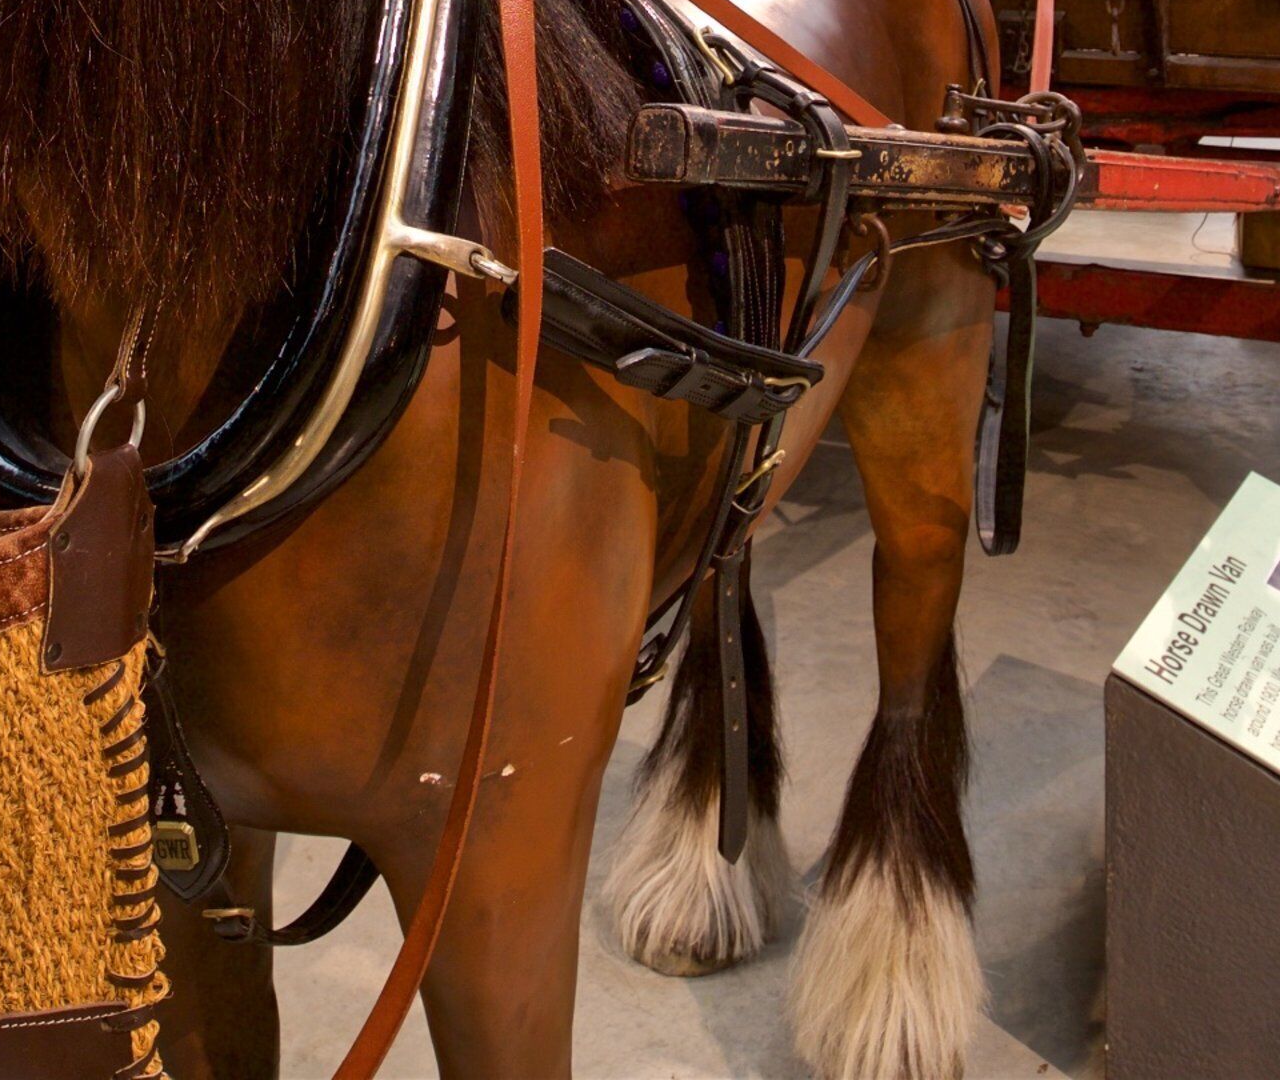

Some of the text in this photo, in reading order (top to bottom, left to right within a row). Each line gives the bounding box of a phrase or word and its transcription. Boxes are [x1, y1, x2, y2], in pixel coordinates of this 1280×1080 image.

[1144, 556, 1246, 685] Horse Drawn Van
[158, 838, 188, 859] GWR
